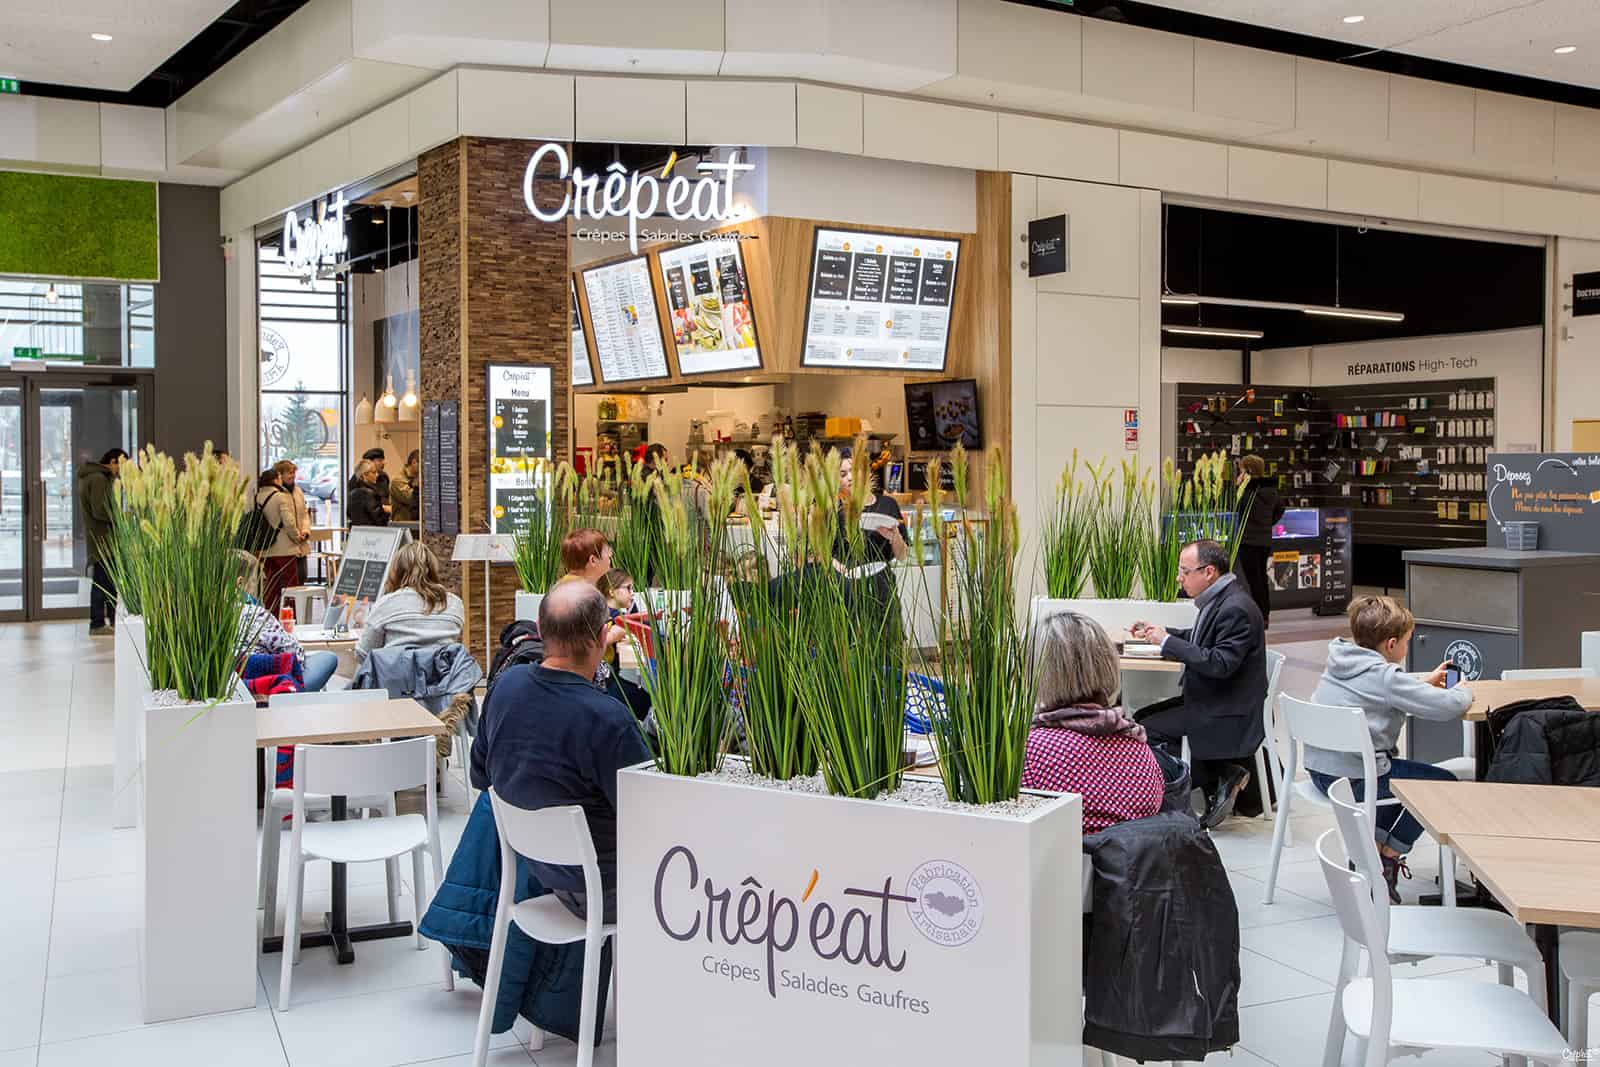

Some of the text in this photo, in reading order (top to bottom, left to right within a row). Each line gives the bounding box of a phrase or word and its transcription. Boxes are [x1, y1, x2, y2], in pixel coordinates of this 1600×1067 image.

[523, 143, 755, 255] Crêp'eat
[576, 228, 752, 244] Crêpes Salades Gauf
[1347, 356, 1478, 376] RÉPARATIONS High-Tech
[1493, 463, 1531, 486] Déposez
[911, 864, 978, 907] Fabrication
[654, 845, 917, 999] Crêp'eat
[911, 911, 977, 941] Artisanale
[702, 955, 930, 1015] Crêpes Salades Gaufres
